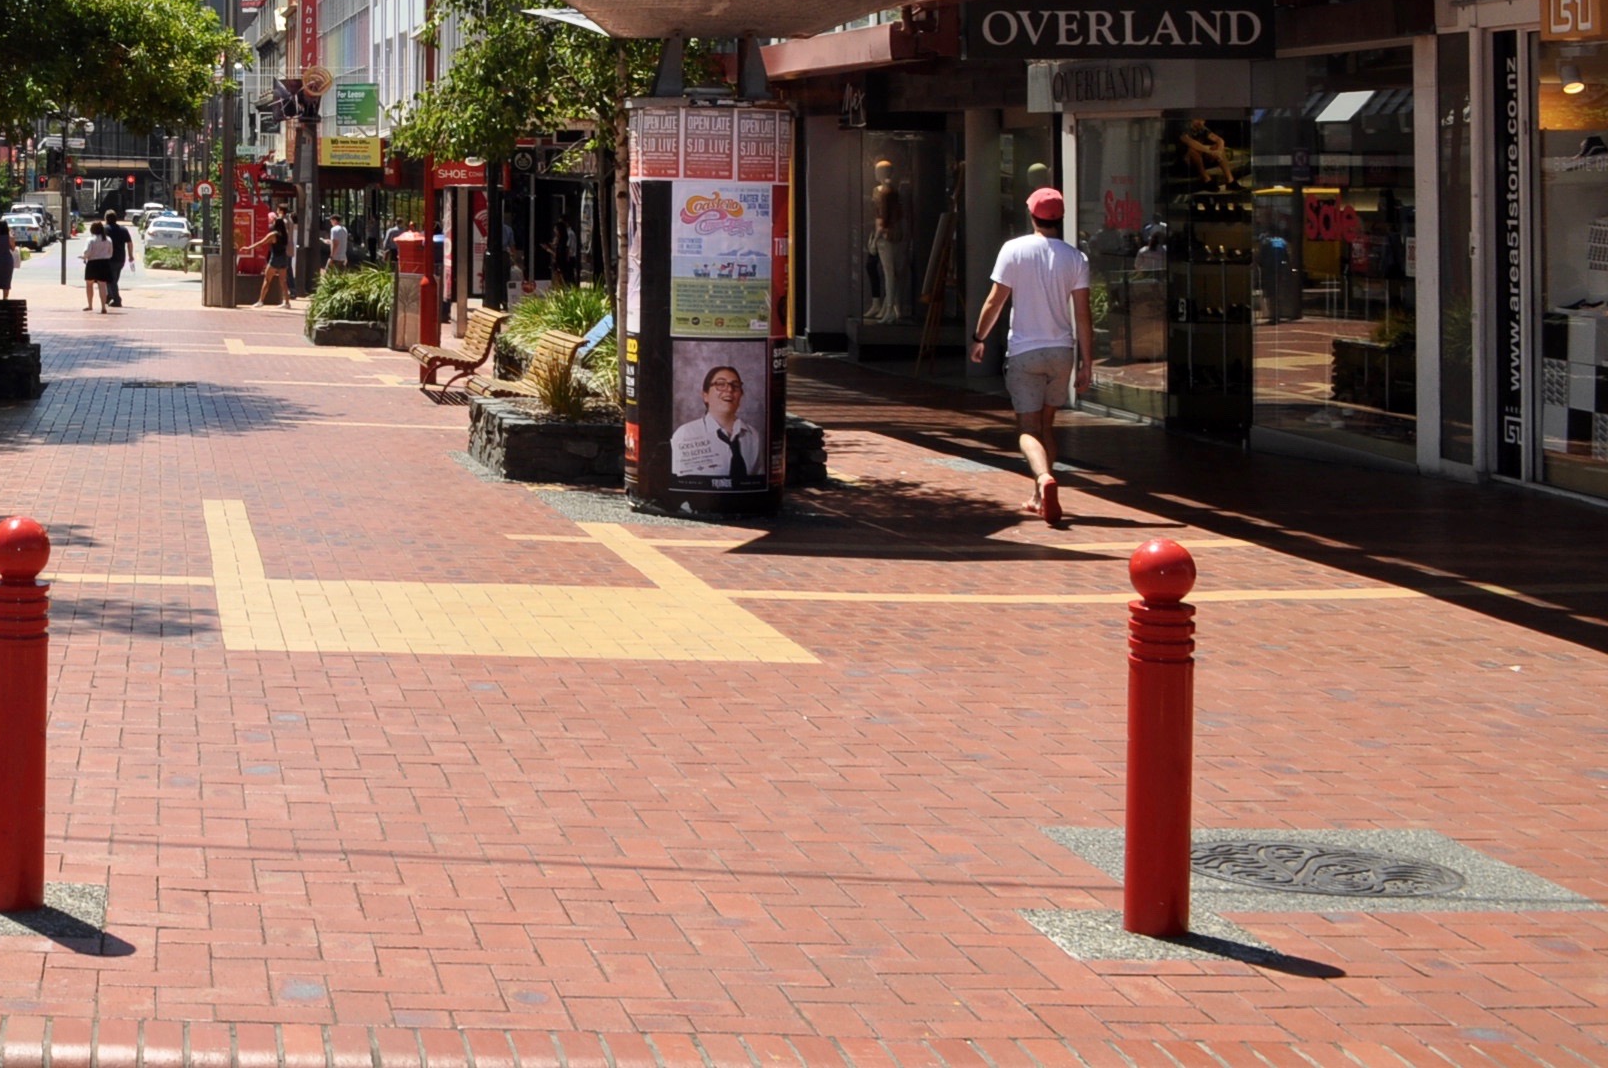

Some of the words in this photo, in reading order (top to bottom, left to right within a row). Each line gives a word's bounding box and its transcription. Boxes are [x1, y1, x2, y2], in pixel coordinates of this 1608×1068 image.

[982, 10, 1262, 46] OVERLAND
[1052, 64, 1154, 103] OVERLAND
[644, 116, 659, 129] OPEN
[661, 116, 677, 129] LATE
[687, 116, 709, 130] OPEN
[711, 117, 731, 131] LATE
[741, 120, 759, 133] OPEN
[760, 120, 775, 133] LATE
[659, 138, 677, 152] LIVE
[687, 139, 704, 152] SJD
[709, 139, 730, 153] LIVE
[759, 142, 775, 156] LIVE
[438, 170, 467, 179] SHOE
[1104, 190, 1143, 231] Sale
[1304, 193, 1361, 242] Sale
[1506, 56, 1520, 391] www.area51store.co.nz
